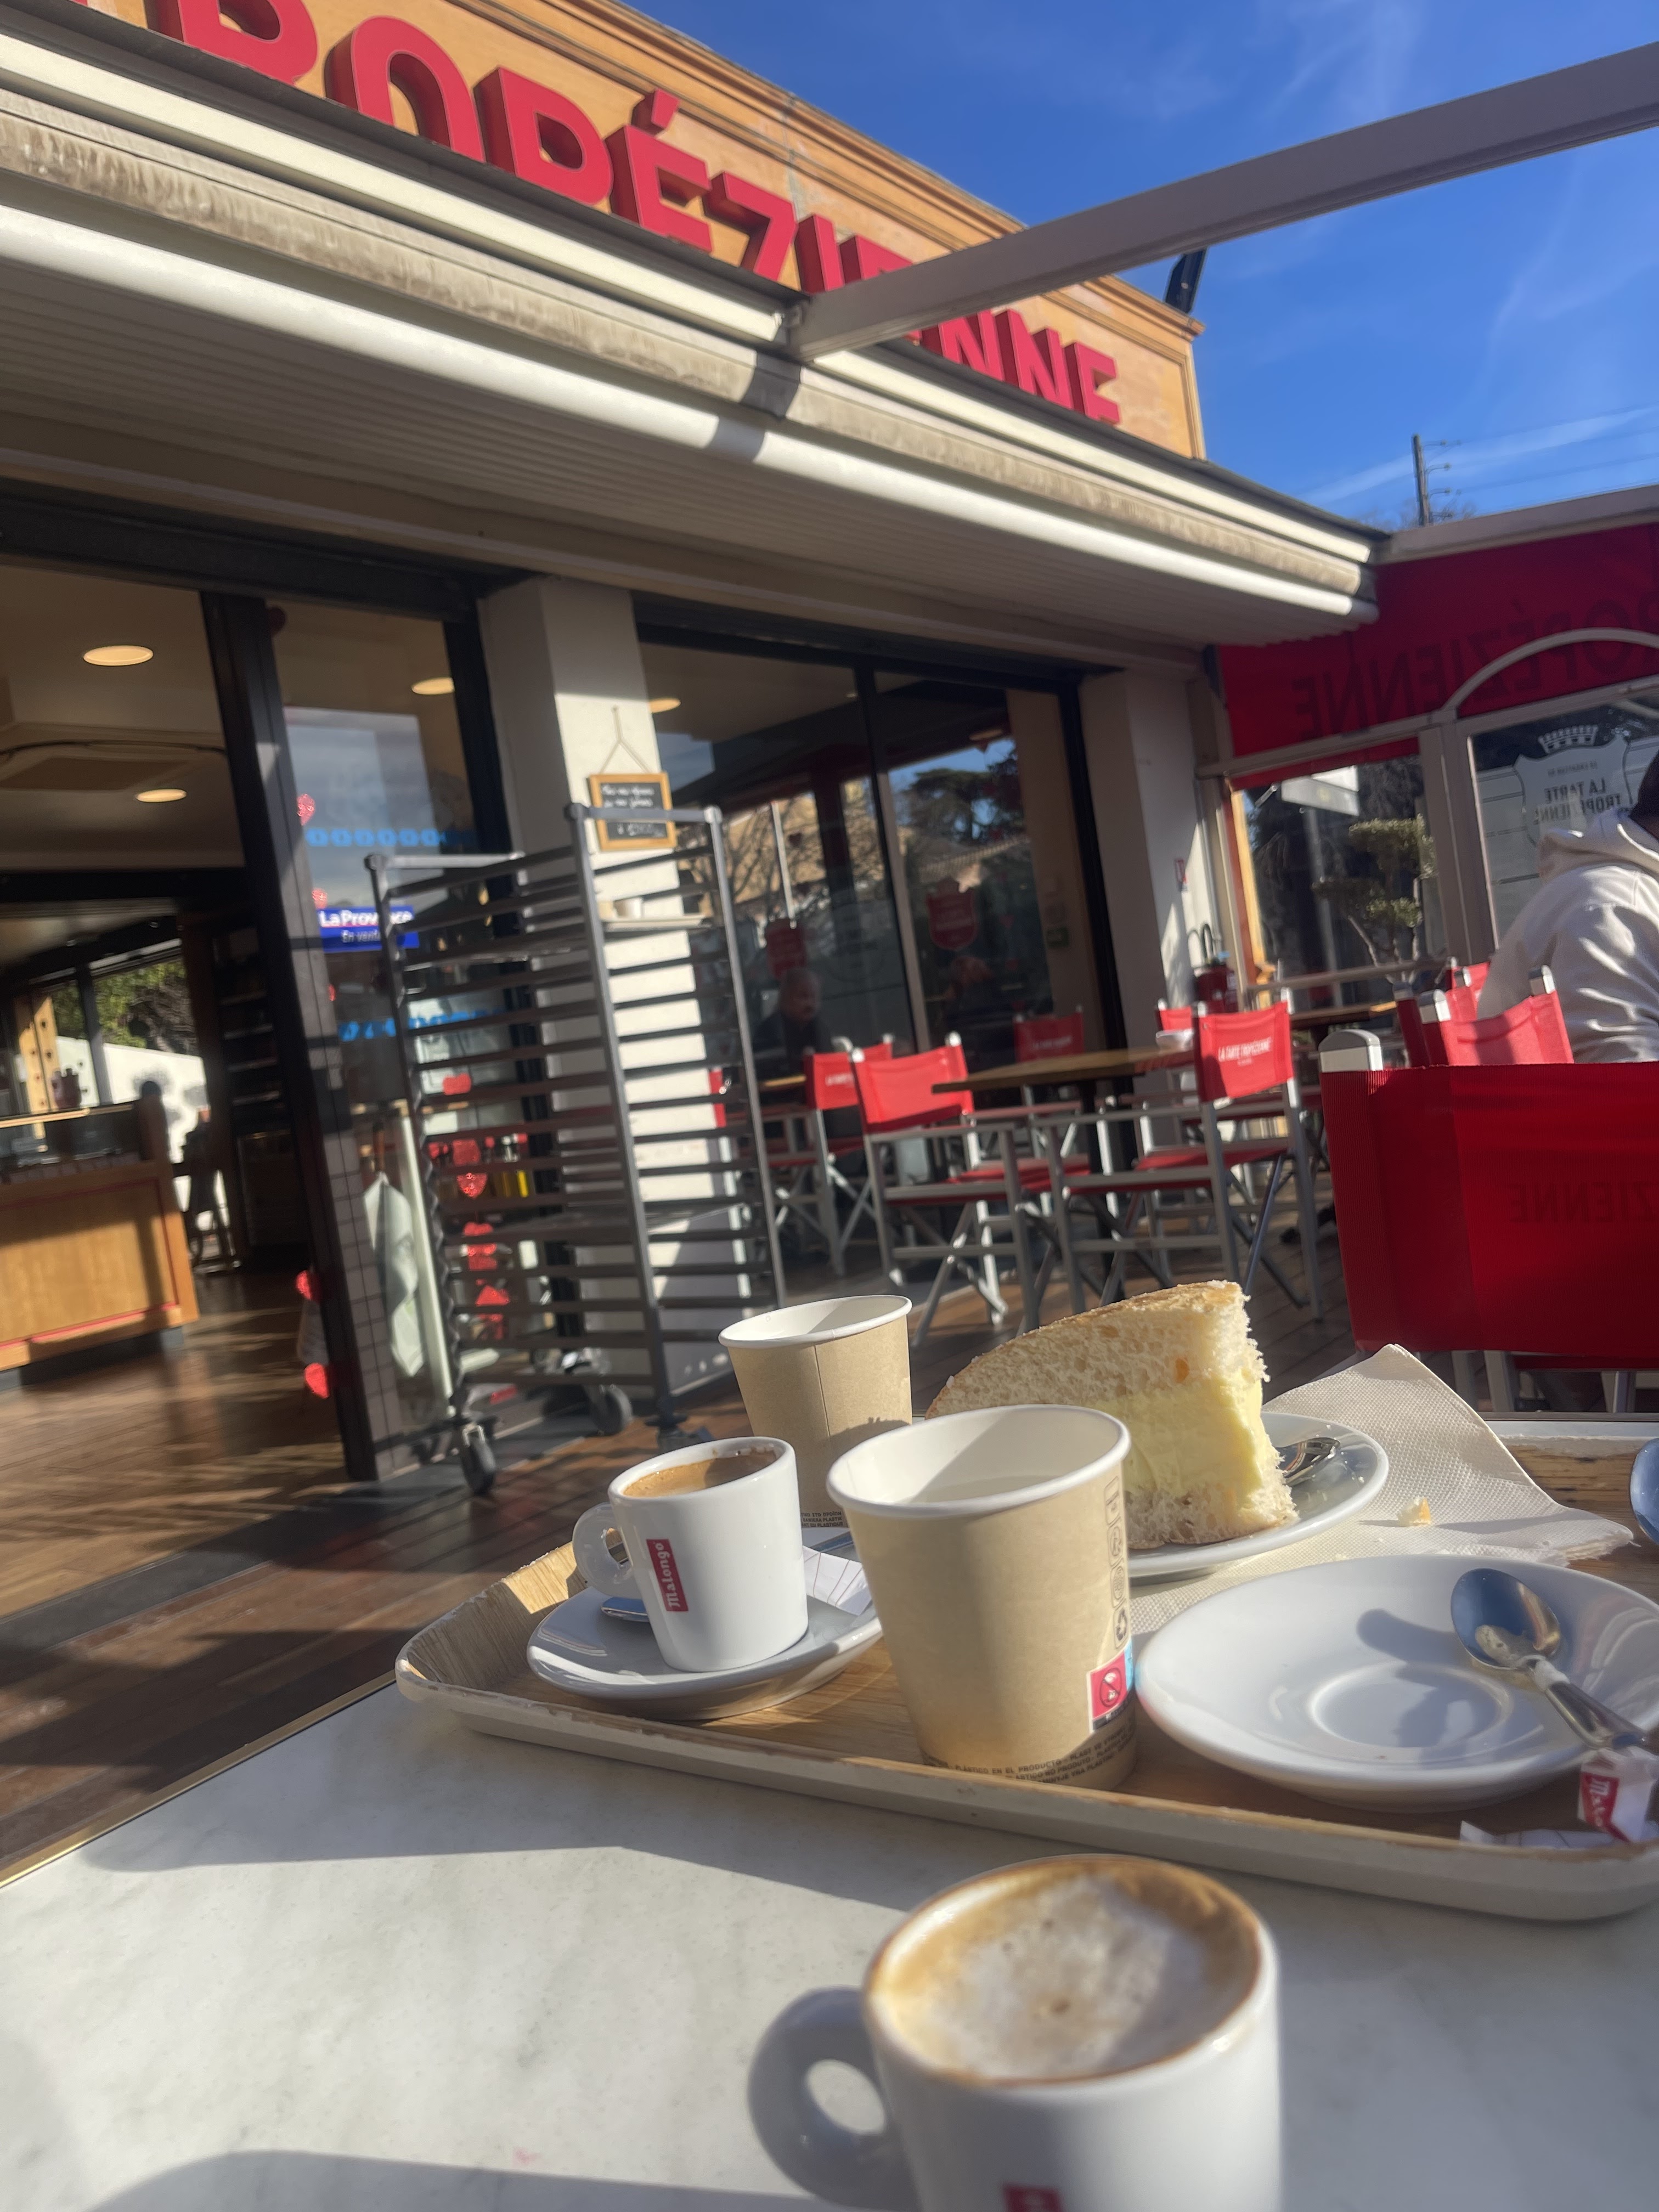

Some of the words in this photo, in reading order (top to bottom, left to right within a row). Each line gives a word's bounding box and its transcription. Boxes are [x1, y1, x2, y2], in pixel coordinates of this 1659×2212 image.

[357, 929, 381, 942] vent
[1018, 1758, 1063, 1773] PRODUCTO
[1058, 1757, 1091, 1773] PRODUTO
